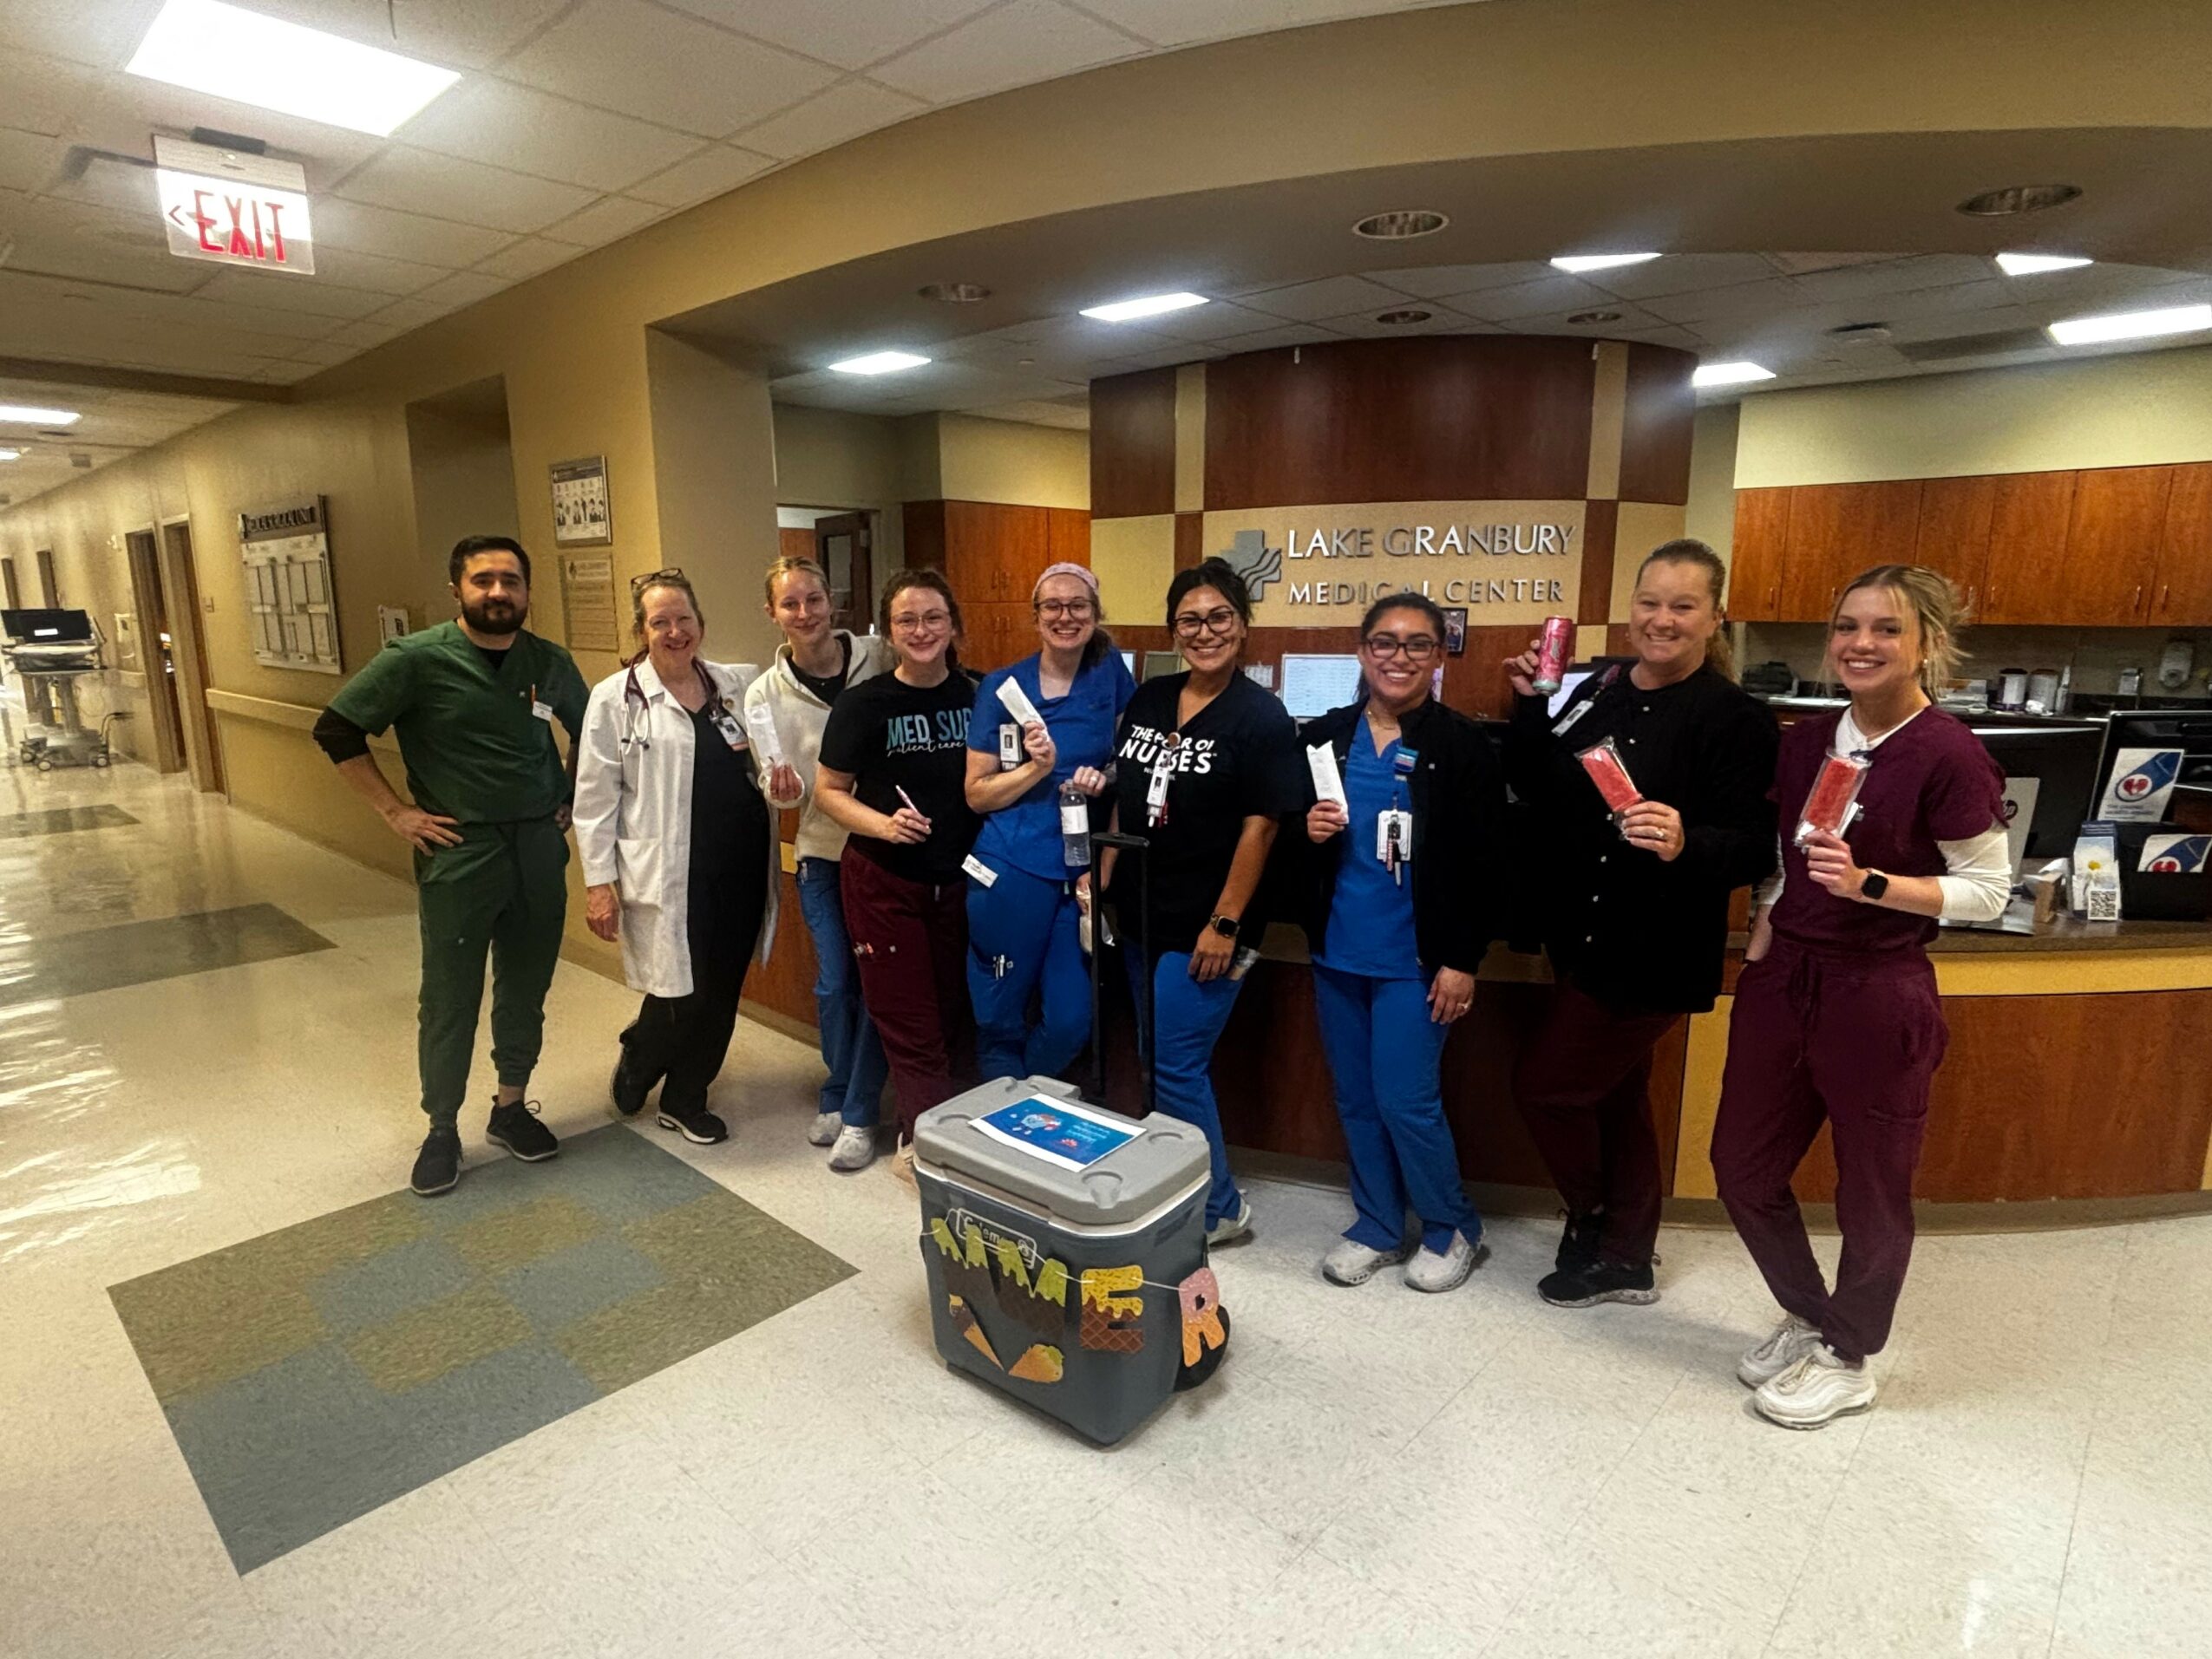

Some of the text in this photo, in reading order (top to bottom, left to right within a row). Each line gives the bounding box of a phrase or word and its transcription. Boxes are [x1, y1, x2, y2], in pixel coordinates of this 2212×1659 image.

[193, 189, 286, 264] EXIT
[1287, 524, 1576, 558] LAKE GRANBURY
[1445, 578, 1564, 603] CENTER
[886, 714, 930, 751] MED
